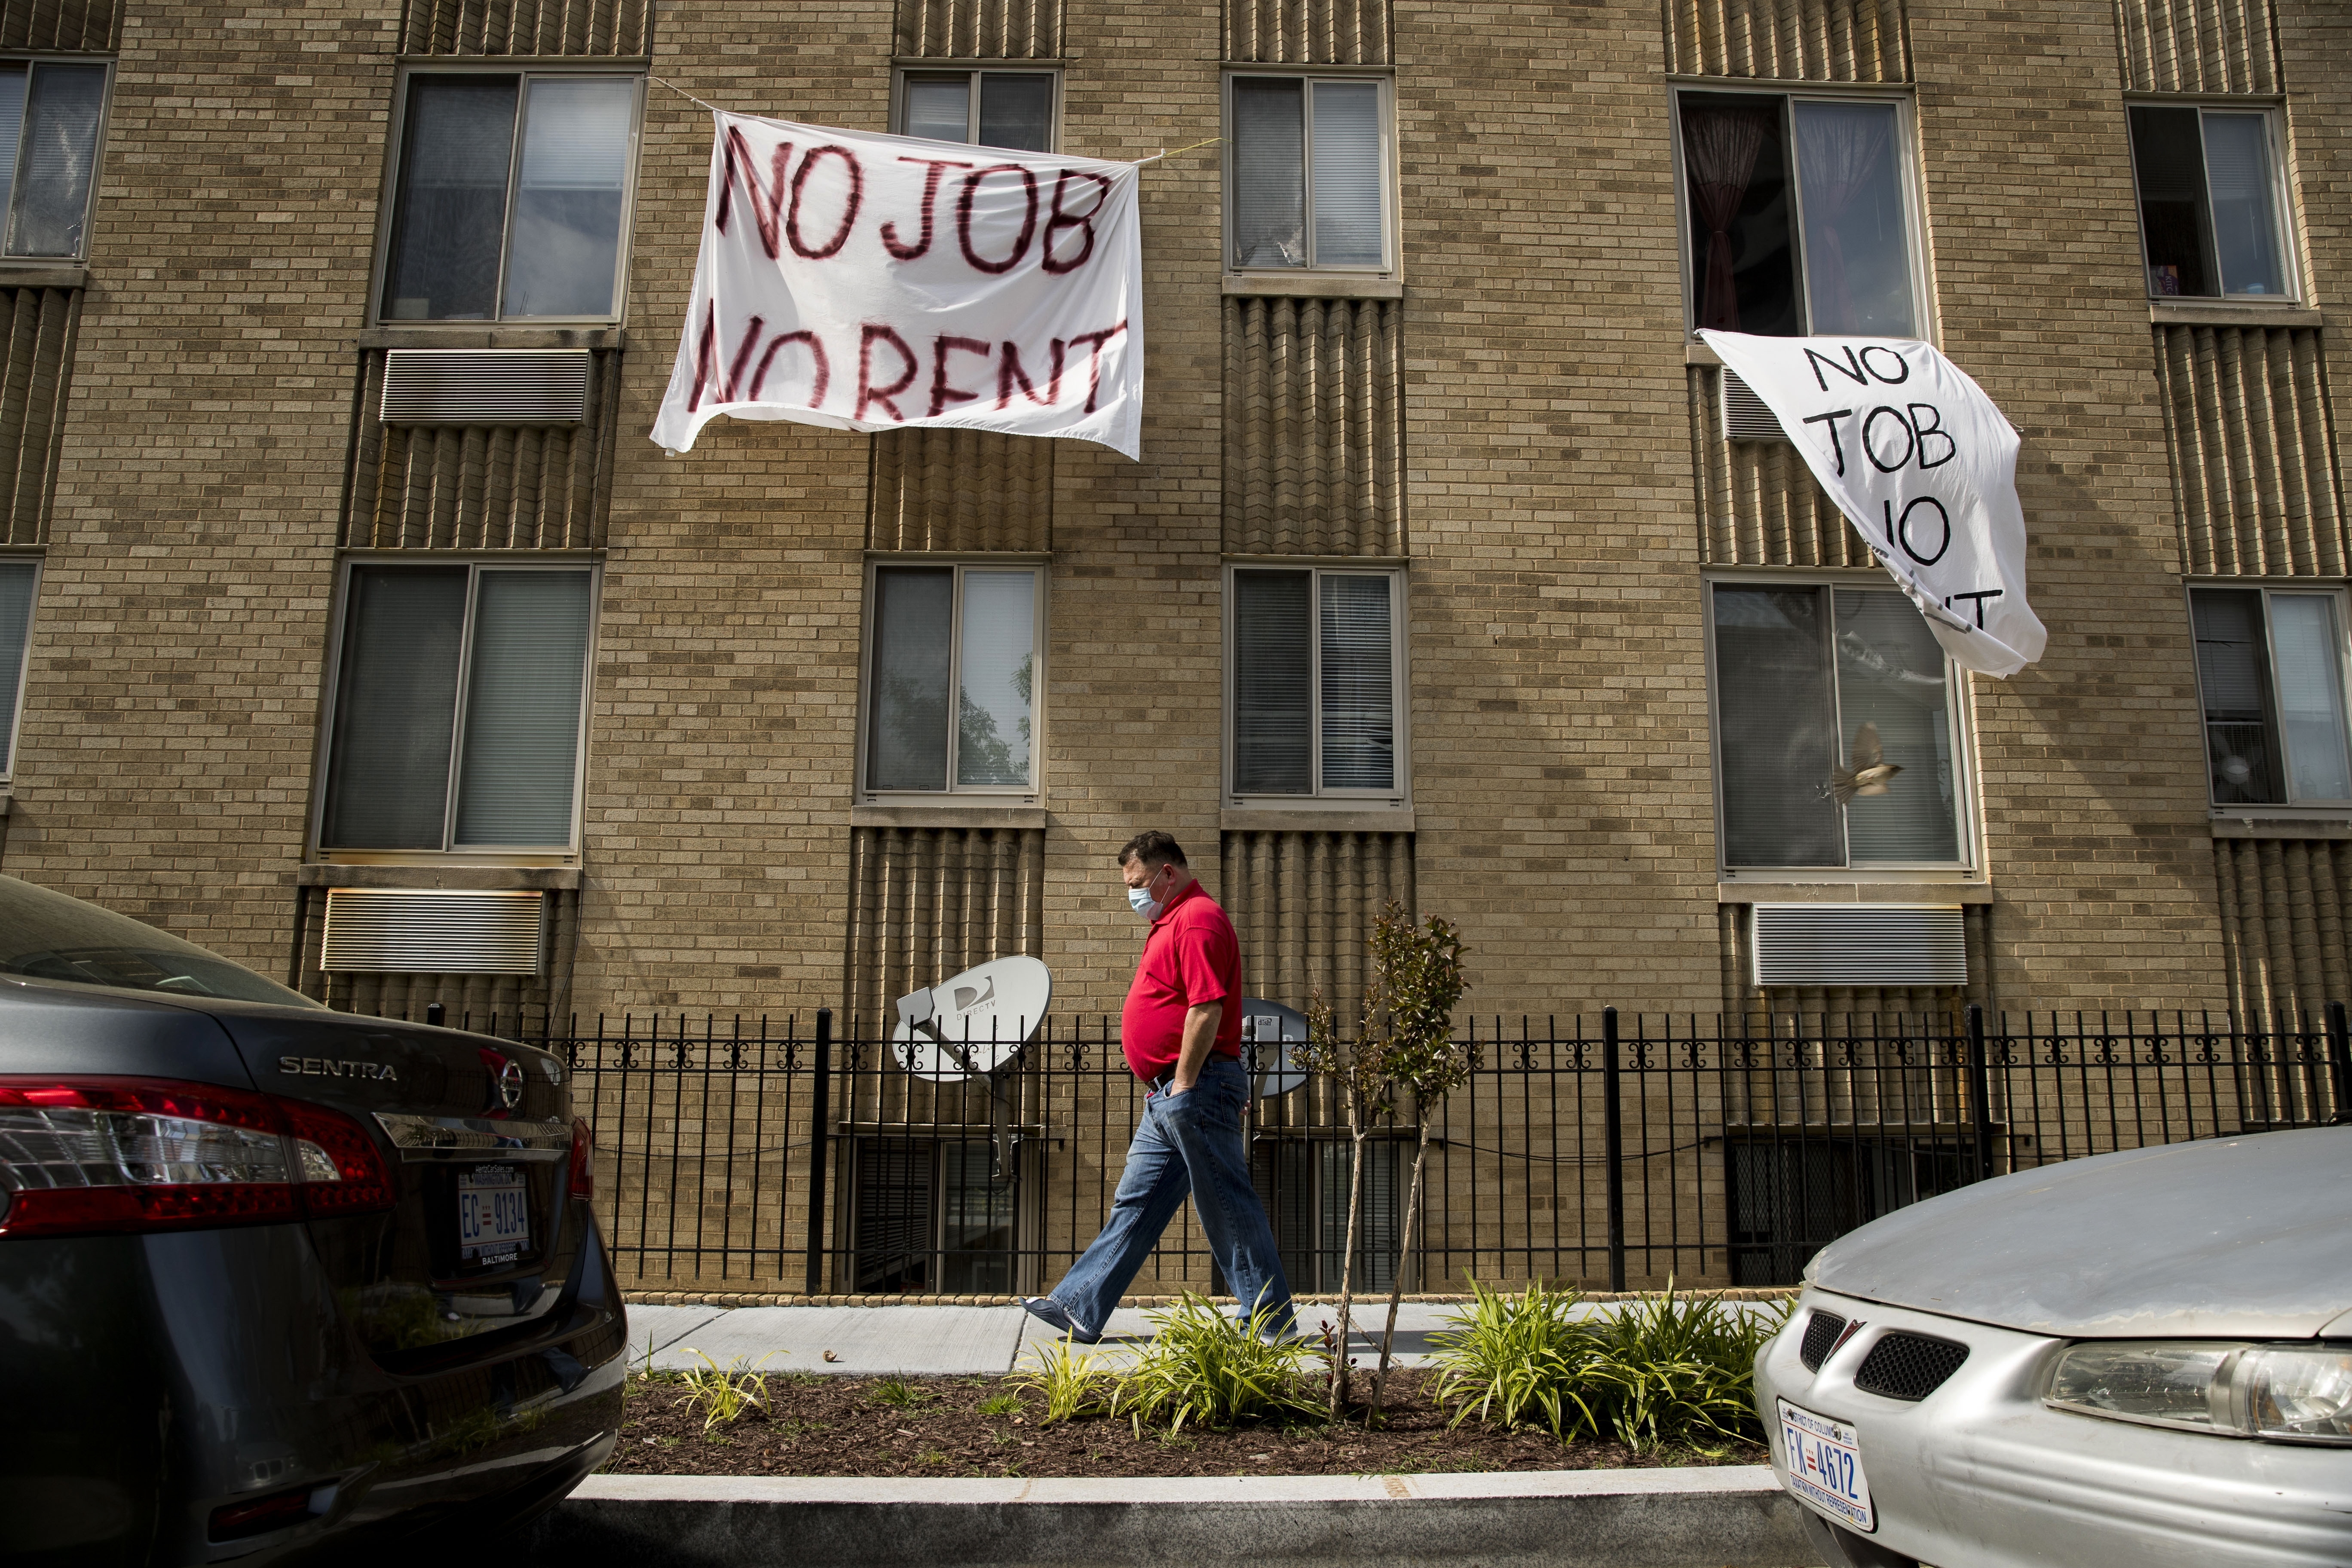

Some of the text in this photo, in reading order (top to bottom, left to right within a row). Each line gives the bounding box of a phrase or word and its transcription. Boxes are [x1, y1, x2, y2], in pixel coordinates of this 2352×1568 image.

[715, 124, 1112, 275] NO JOB
[687, 297, 1128, 423] NO RENT
[1803, 346, 1908, 392] NO
[956, 999, 996, 1021] DIRECTV
[1258, 1018, 1272, 1026] dish
[279, 1056, 398, 1081] SENTRA
[475, 1164, 514, 1173] HertzCarSales.com
[462, 1191, 525, 1238] EC 9134
[482, 1253, 518, 1265] BALTIMORE
[1791, 1411, 1807, 1427] STRICT
[1807, 1418, 1813, 1430] OF
[1814, 1421, 1835, 1438] COLUM
[1787, 1427, 1858, 1500] FK 4672
[1790, 1475, 1809, 1494] TAXATION
[1808, 1485, 1827, 1504] WITHOUT
